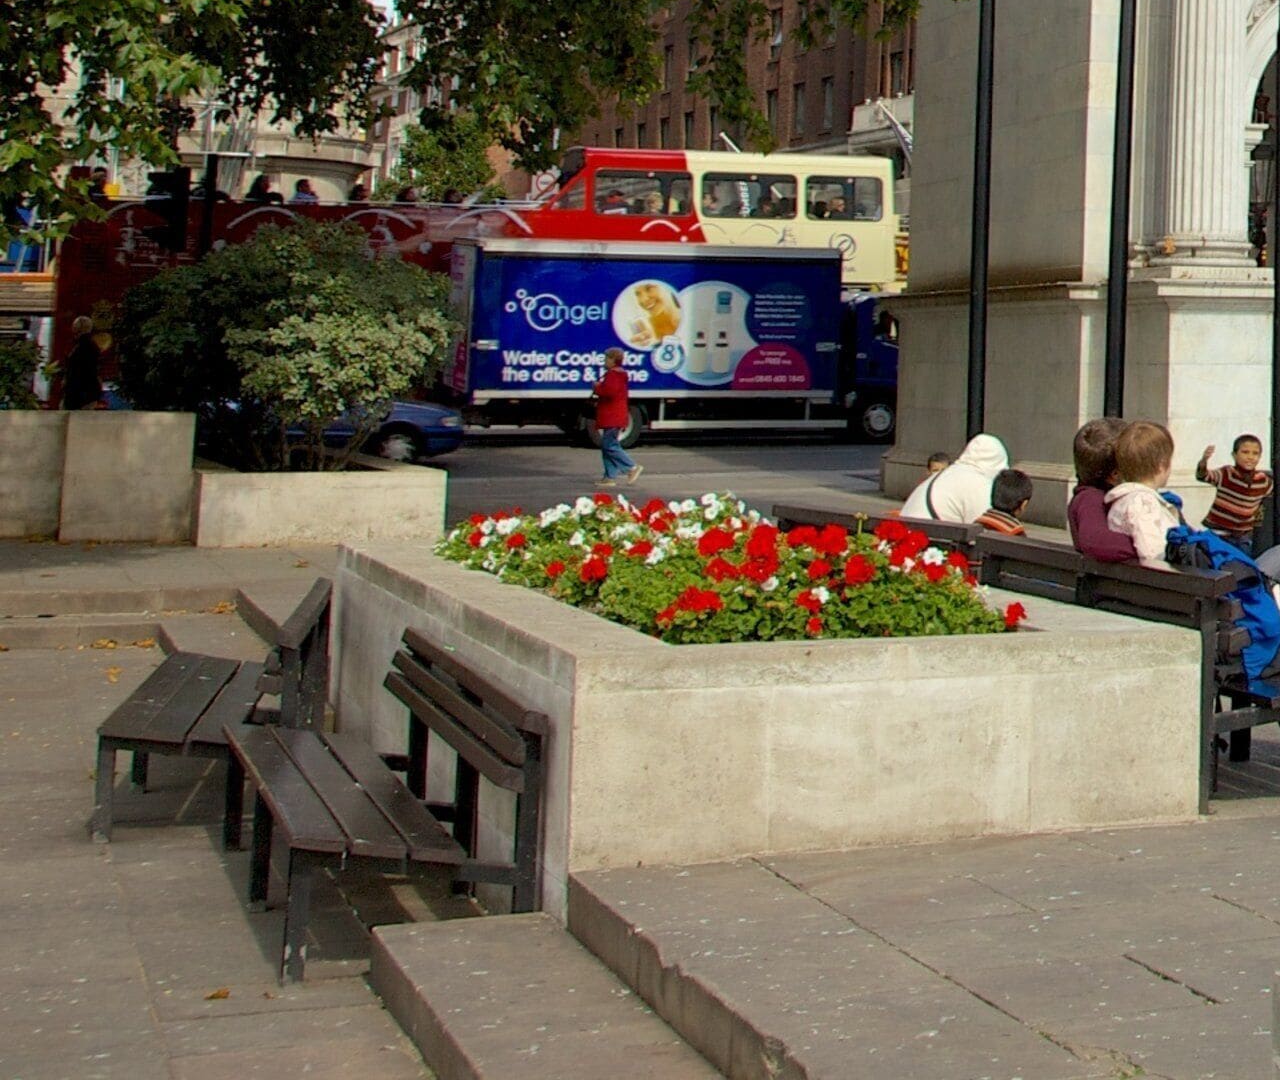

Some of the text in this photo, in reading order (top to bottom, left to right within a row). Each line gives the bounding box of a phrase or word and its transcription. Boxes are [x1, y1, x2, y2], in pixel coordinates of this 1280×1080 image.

[538, 301, 608, 325] angel
[503, 350, 645, 366] Water Coole for
[662, 344, 675, 361] 8
[502, 367, 529, 382] the
[532, 367, 580, 382] office
[583, 367, 596, 382] &
